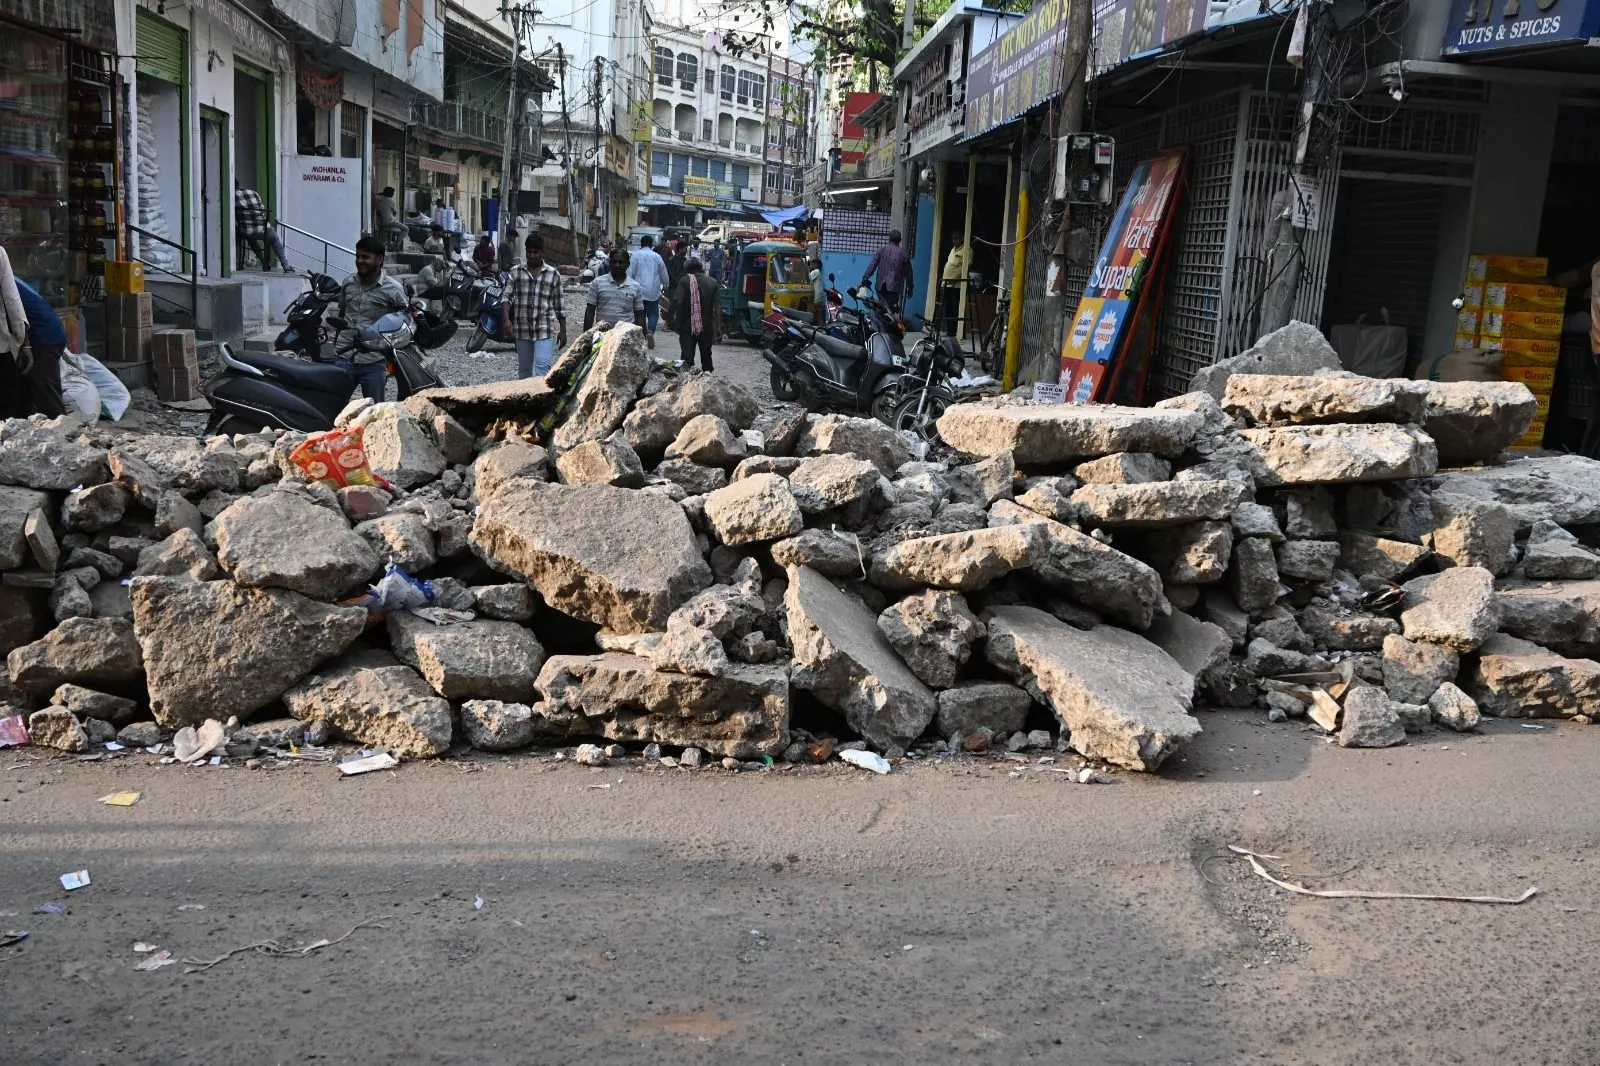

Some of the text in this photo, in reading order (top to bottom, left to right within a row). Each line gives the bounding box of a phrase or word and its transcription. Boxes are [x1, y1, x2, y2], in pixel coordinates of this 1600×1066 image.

[1016, 13, 1036, 54] NUTS
[1458, 16, 1561, 45] NUTS & SPICES
[312, 166, 347, 174] MOHANLAL
[303, 174, 331, 182] DAYARAM
[1517, 260, 1545, 270] Classic
[1537, 289, 1564, 298] Classic
[1534, 316, 1560, 325] Classic
[1531, 343, 1558, 353] Classic
[1524, 371, 1552, 380] Classic
